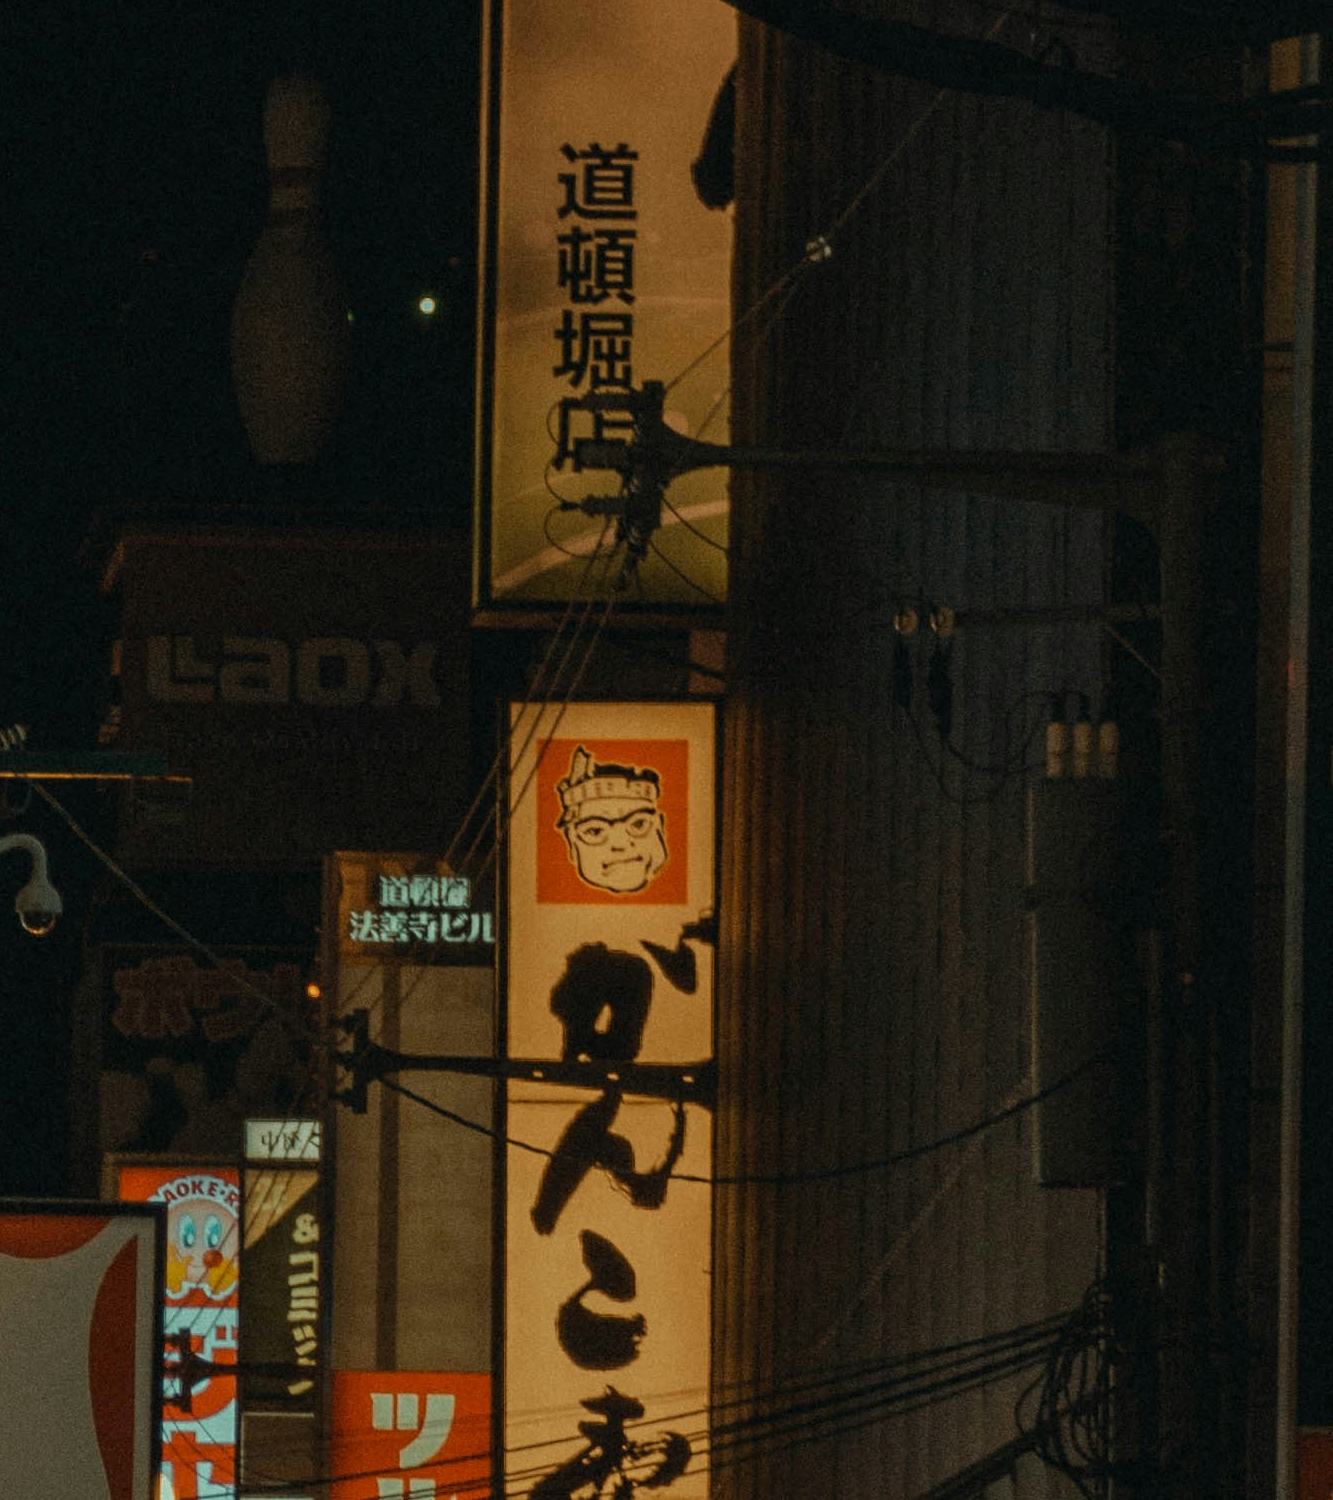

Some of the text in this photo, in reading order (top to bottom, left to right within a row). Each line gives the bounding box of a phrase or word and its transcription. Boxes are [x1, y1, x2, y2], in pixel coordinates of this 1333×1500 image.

[377, 875, 470, 909] 道頓堀
[349, 910, 495, 943] 法善寺ビル
